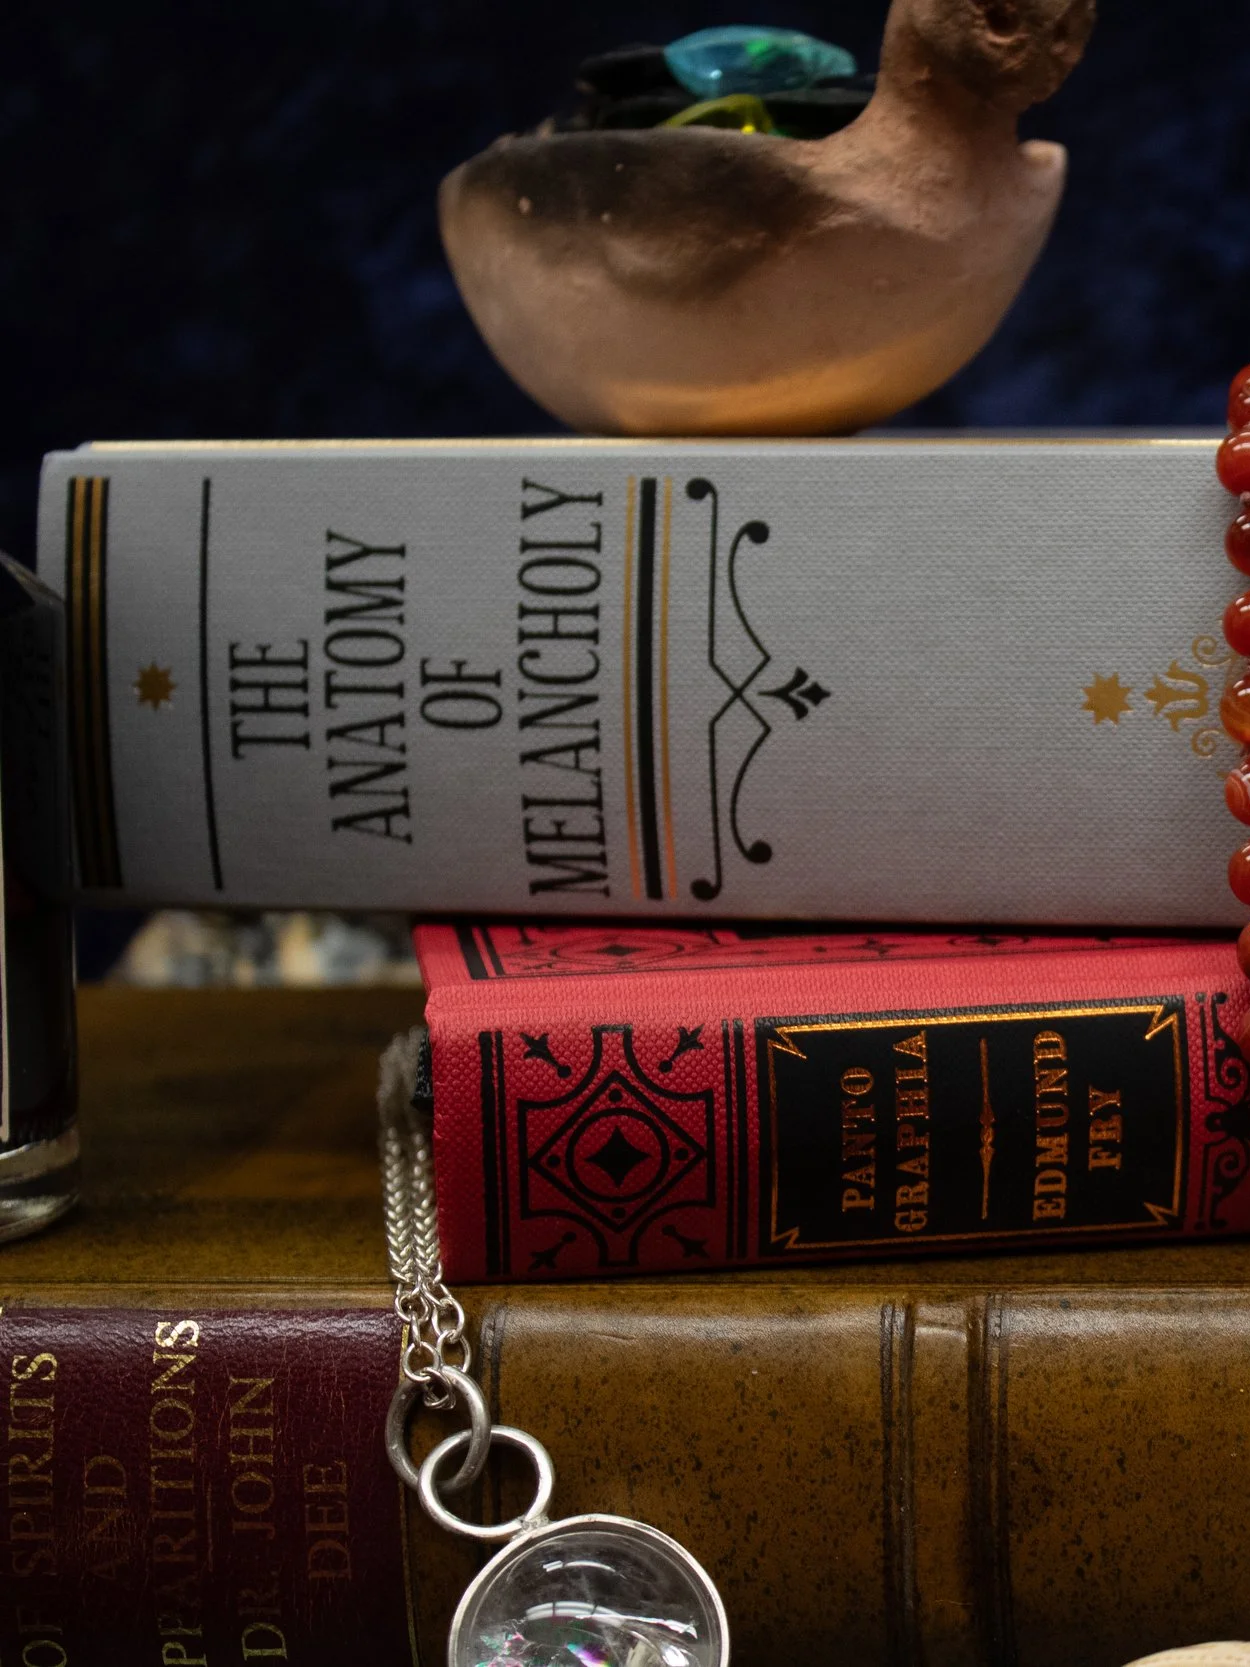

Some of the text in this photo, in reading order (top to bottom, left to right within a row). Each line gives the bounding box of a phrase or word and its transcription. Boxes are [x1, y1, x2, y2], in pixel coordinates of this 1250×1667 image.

[230, 639, 310, 759] THE
[325, 529, 412, 844] ANATOMY
[420, 657, 503, 730] OF
[518, 477, 610, 897] MELANCHOLY
[840, 1067, 875, 1213] PANTO
[893, 1030, 930, 1231] GRAPHIA
[1032, 1030, 1070, 1221] EDMUND
[1088, 1085, 1123, 1171] FRY
[8, 1352, 58, 1577] SPIRITS
[84, 1454, 129, 1580] AND
[229, 1377, 276, 1541] JOHN
[302, 1459, 352, 1581] DEE
